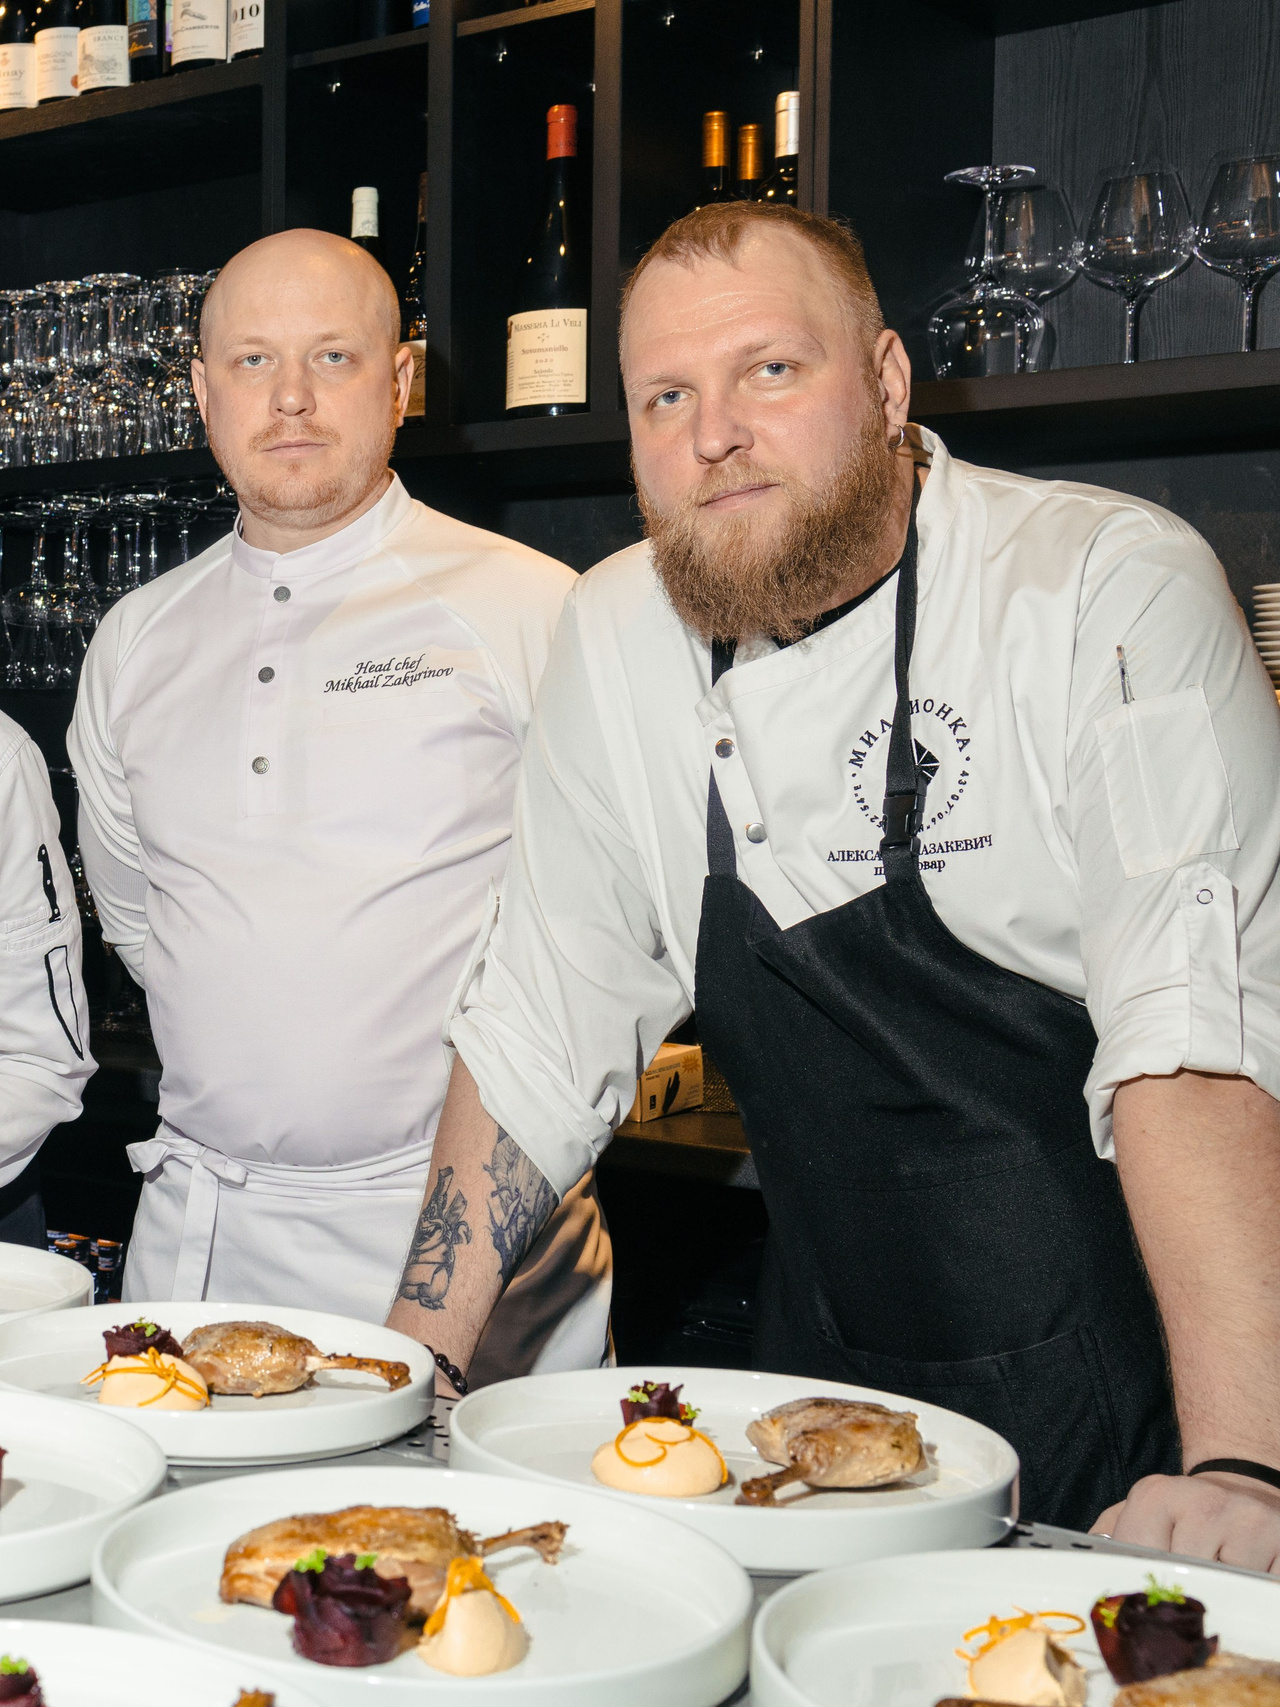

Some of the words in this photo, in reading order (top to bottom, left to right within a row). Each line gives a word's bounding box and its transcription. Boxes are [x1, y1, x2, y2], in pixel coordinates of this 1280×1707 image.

[354, 658, 396, 675] Head
[395, 653, 426, 673] chef
[323, 674, 383, 693] Mikhail
[382, 667, 454, 688] Zakurinov
[849, 698, 971, 769] МИЛИОНКА
[827, 850, 883, 862] АЛЕКСА
[920, 834, 993, 856] АЗАКЕВИЧ
